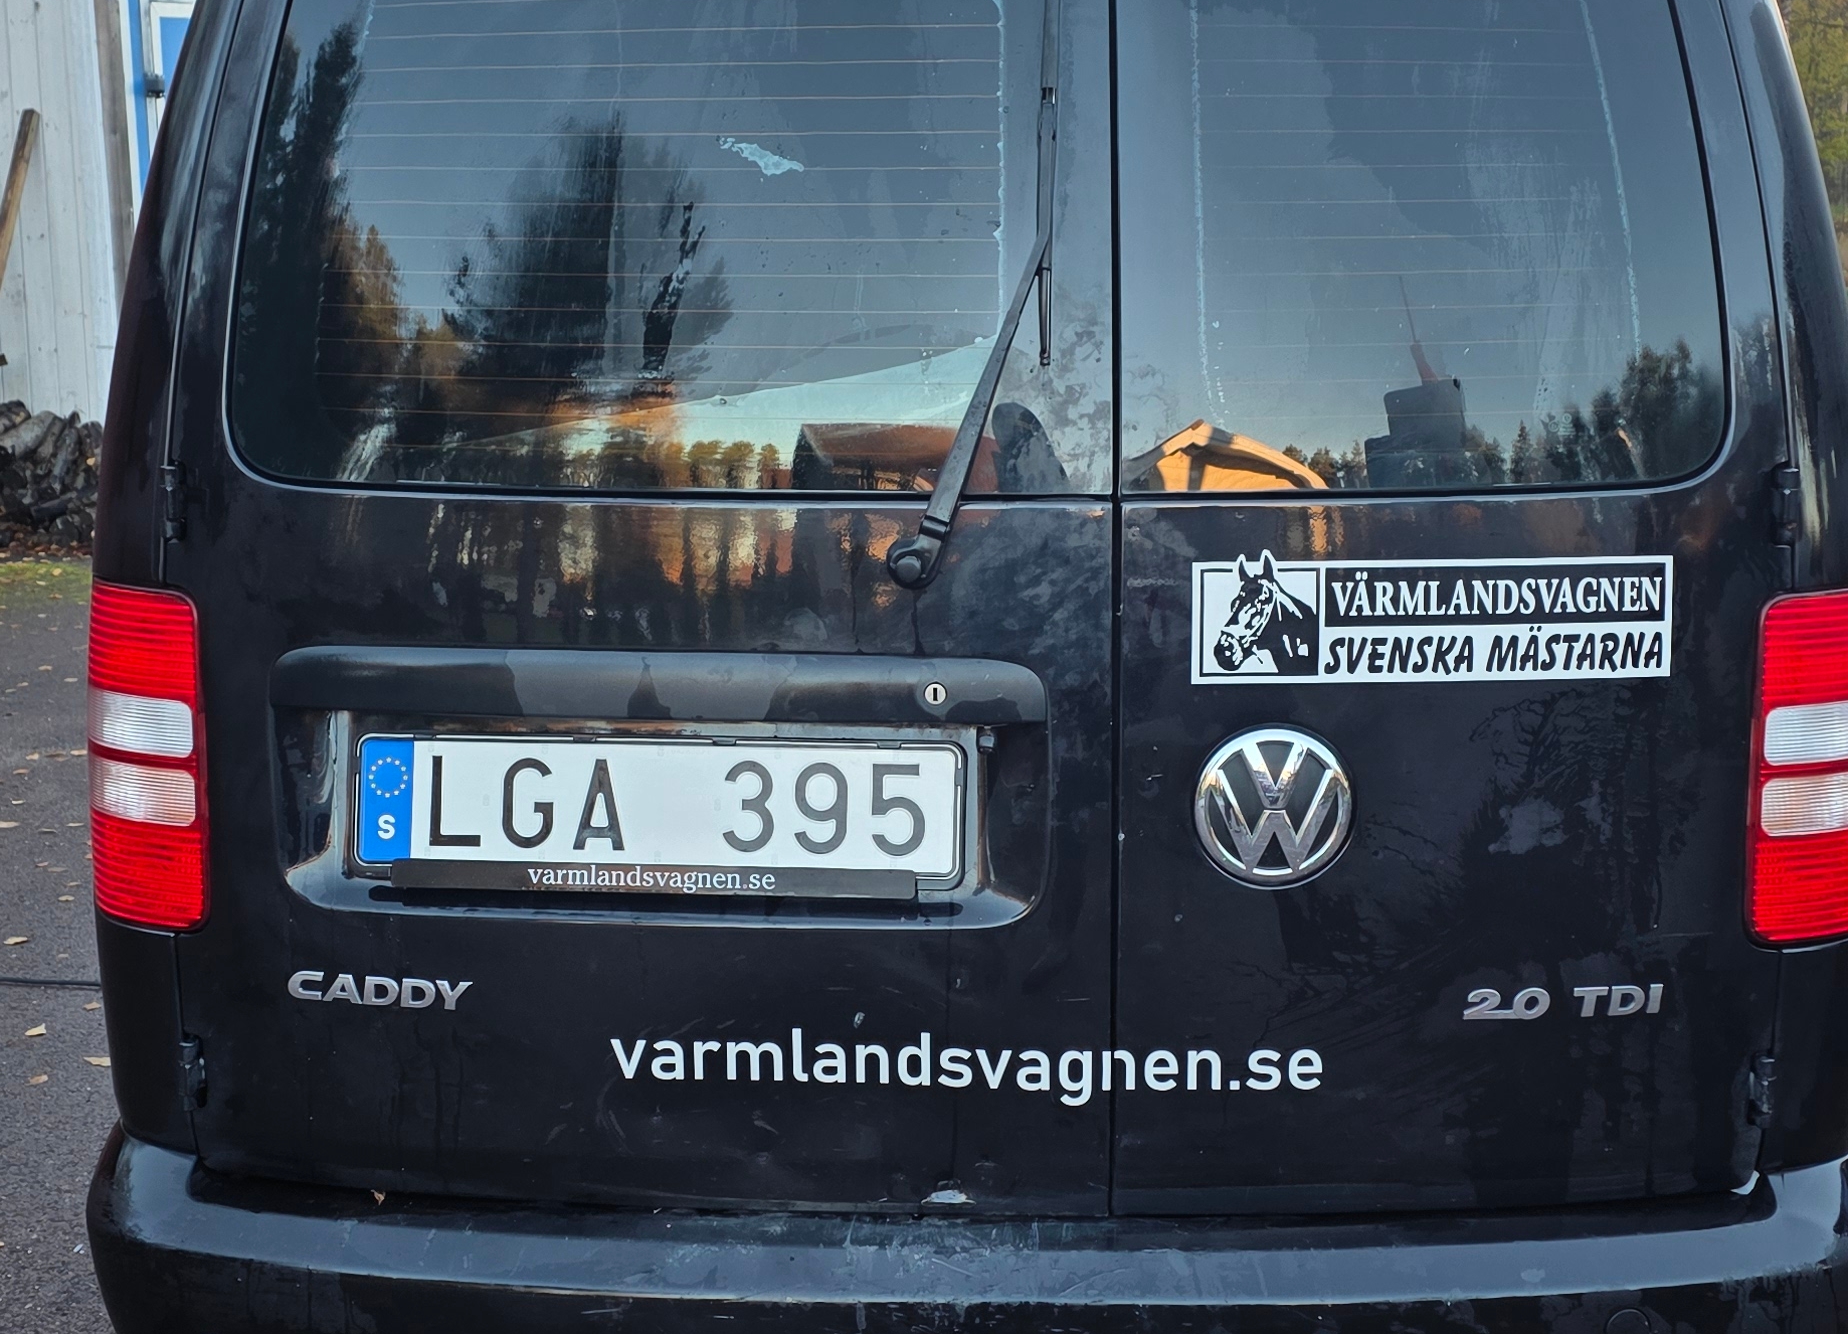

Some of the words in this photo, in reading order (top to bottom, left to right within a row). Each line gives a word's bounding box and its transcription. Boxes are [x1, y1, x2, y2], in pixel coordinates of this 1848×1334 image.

[1330, 570, 1663, 617] VÄRMLANDSVAGNEN
[1323, 634, 1475, 676] SVENSKA
[1485, 624, 1664, 673] MÄSTARNA
[376, 813, 396, 840] S
[428, 754, 626, 852] LGA
[721, 759, 926, 857] 395
[527, 864, 776, 894] varmlandsvagnen.se
[286, 969, 474, 1011] CADDY
[1572, 982, 1665, 1018] TDI
[609, 1027, 1324, 1108] varmlandsvagnen.se
